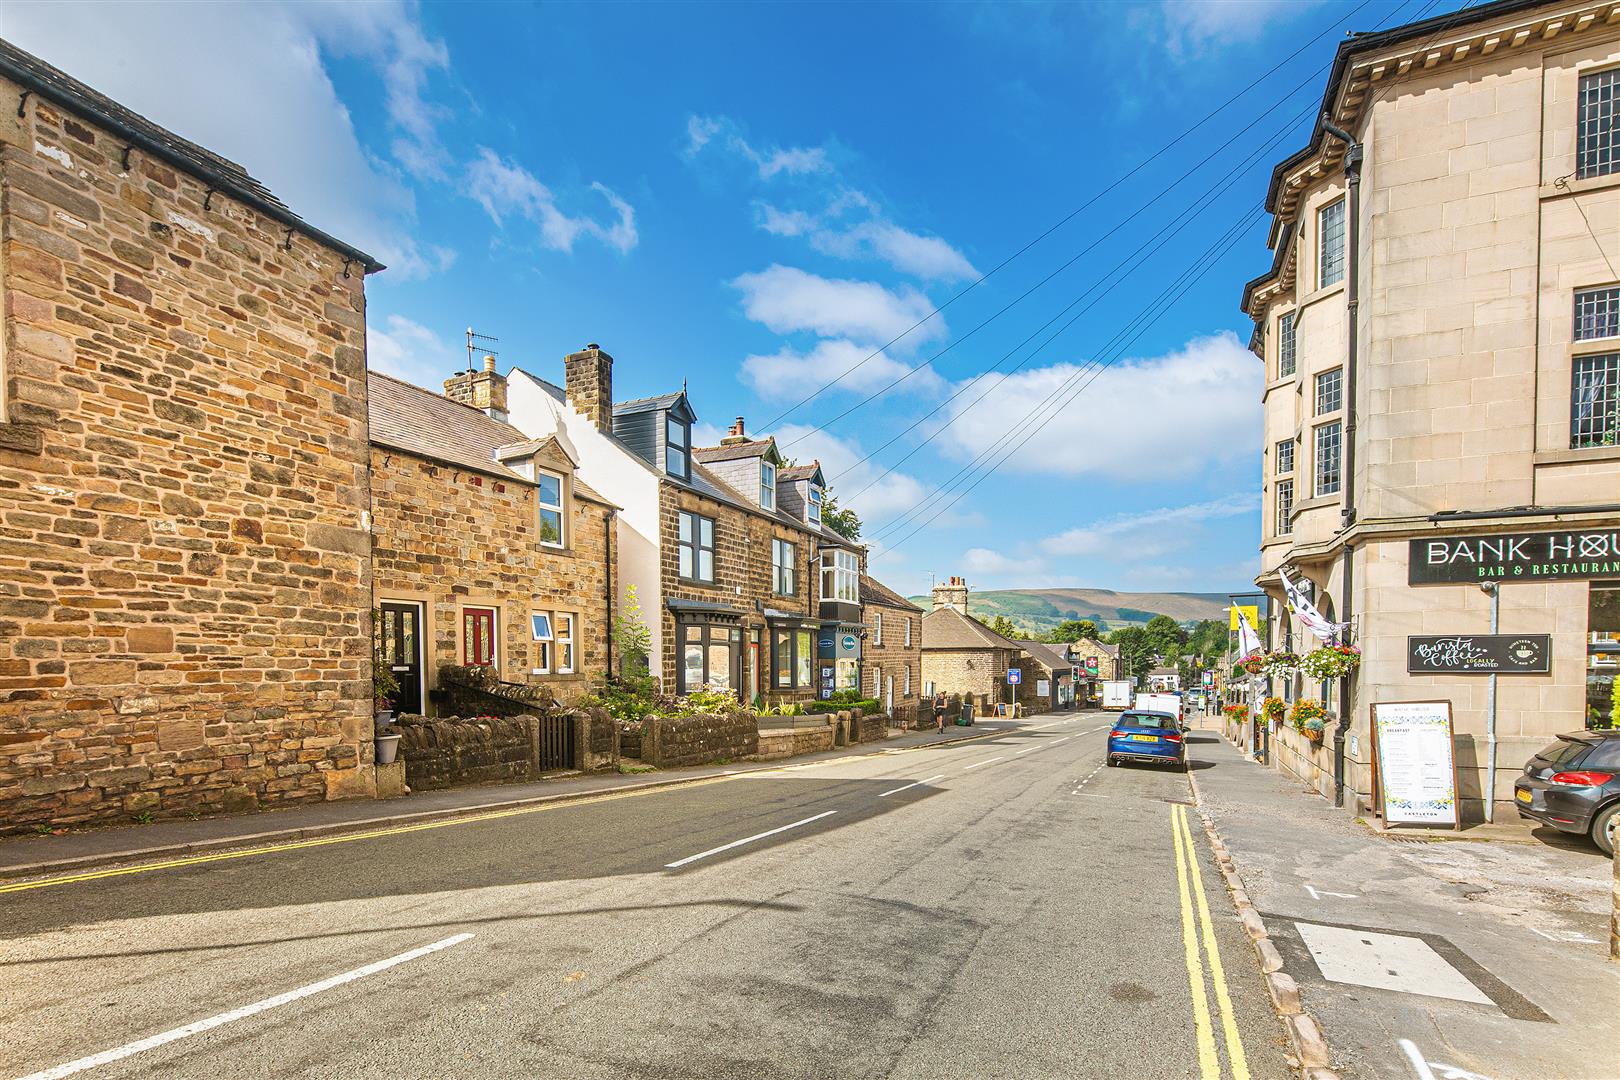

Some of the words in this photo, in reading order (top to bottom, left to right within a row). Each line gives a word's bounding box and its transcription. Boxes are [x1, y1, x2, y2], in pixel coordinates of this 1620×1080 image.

[1428, 537, 1531, 564] BANK
[1478, 566, 1505, 577] BAR
[1514, 565, 1523, 576] &
[1414, 637, 1475, 657] Barista
[1424, 649, 1483, 667] Coffee
